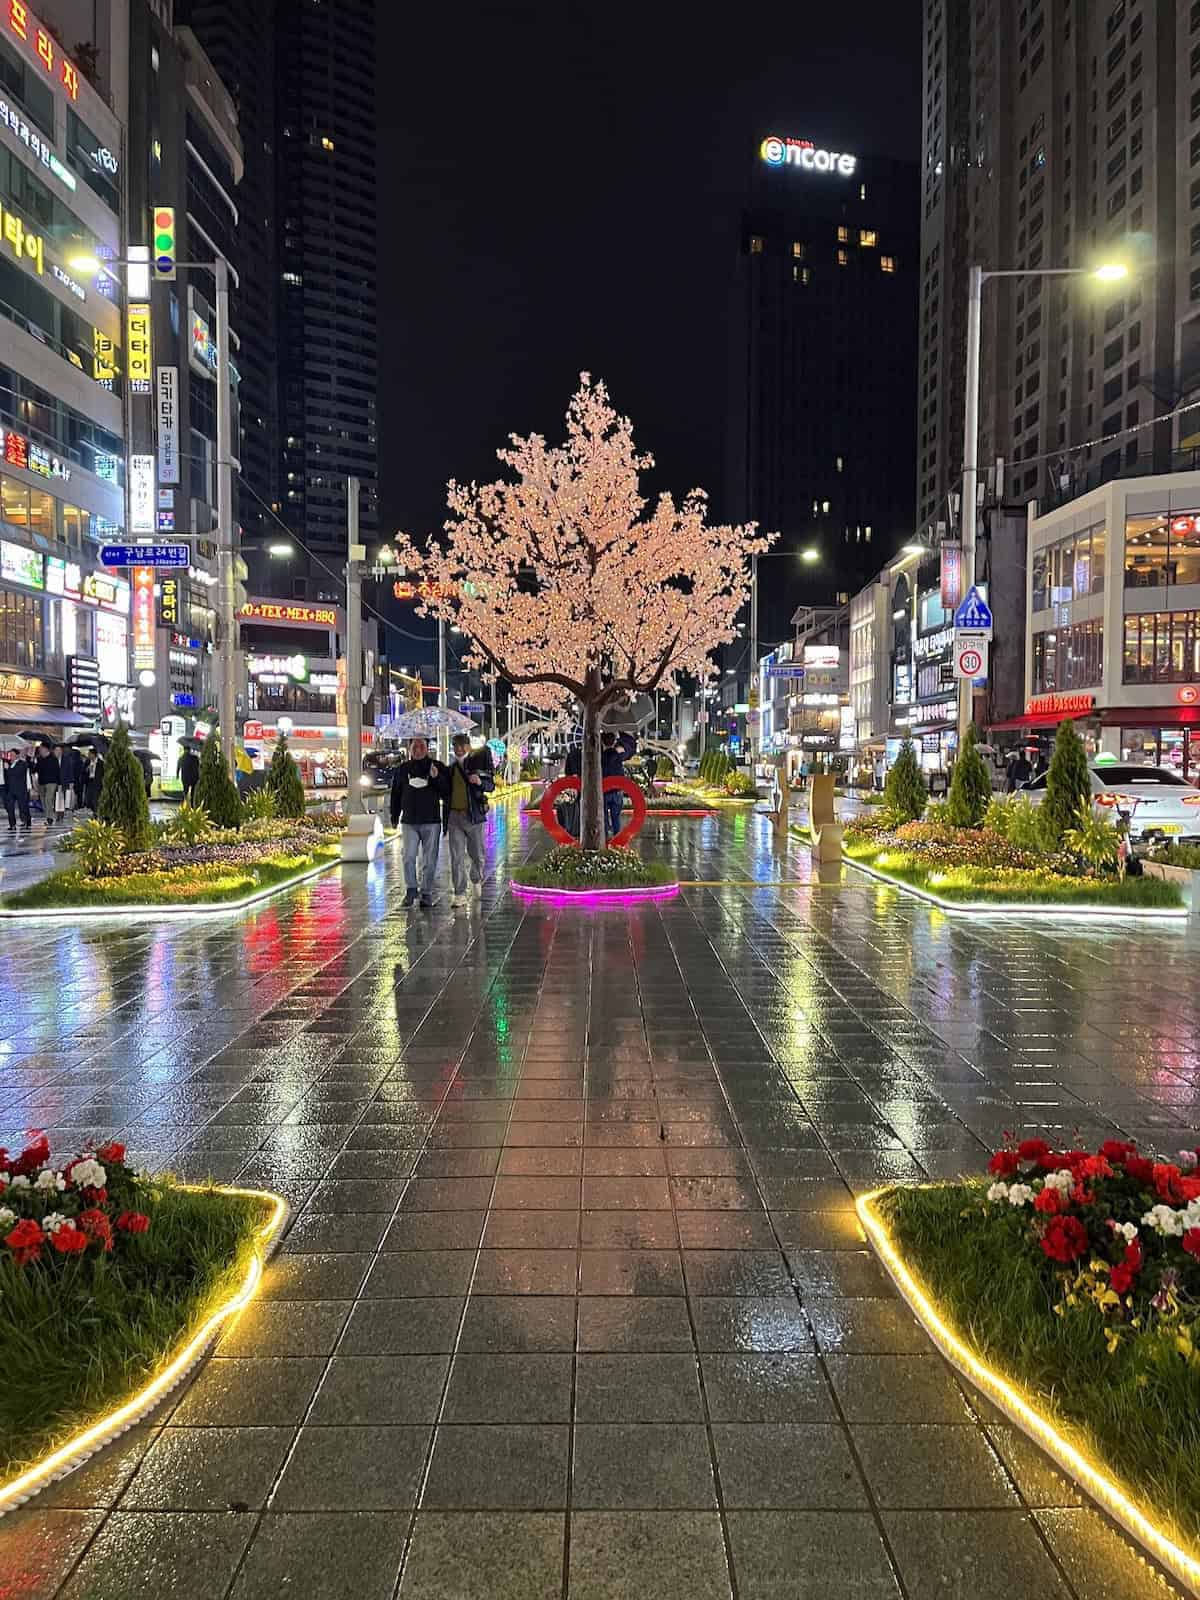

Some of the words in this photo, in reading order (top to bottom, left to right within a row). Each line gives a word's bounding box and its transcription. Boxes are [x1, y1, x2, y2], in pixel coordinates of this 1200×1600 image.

[760, 137, 857, 176] encore
[131, 319, 147, 375] 더타이
[161, 371, 173, 430] 티키타카
[315, 610, 336, 624] BBQ
[963, 656, 978, 669] 30
